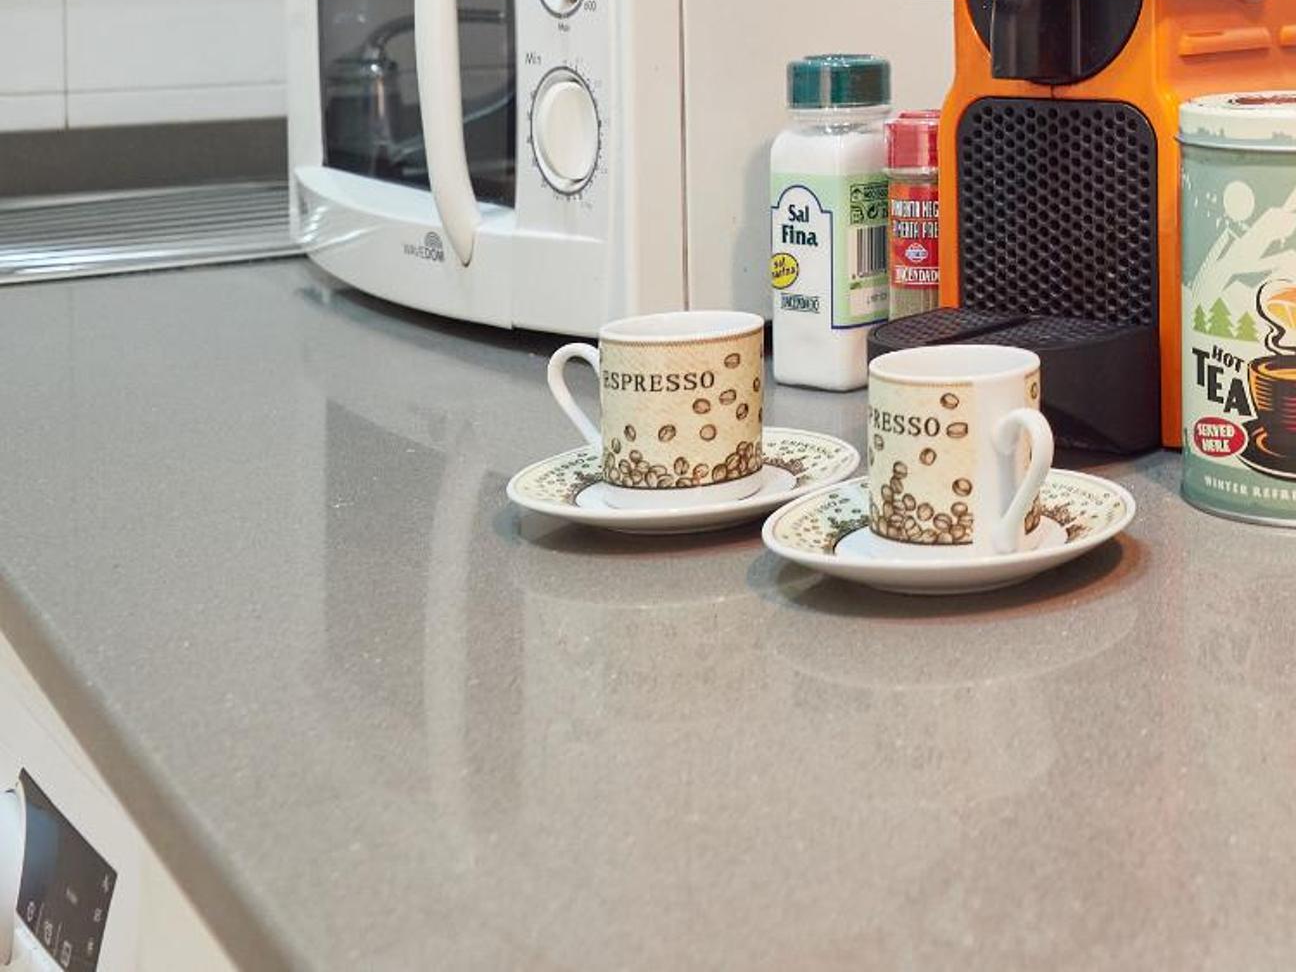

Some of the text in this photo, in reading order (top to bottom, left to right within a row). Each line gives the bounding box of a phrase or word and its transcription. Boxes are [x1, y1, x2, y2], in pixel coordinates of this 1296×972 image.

[525, 51, 541, 66] Min
[788, 204, 810, 223] Sal
[782, 224, 819, 247] Fina
[1211, 344, 1245, 373] HOT
[1192, 346, 1252, 416] TEA
[1197, 422, 1236, 439] SERVED
[1204, 476, 1248, 495] WINTER
